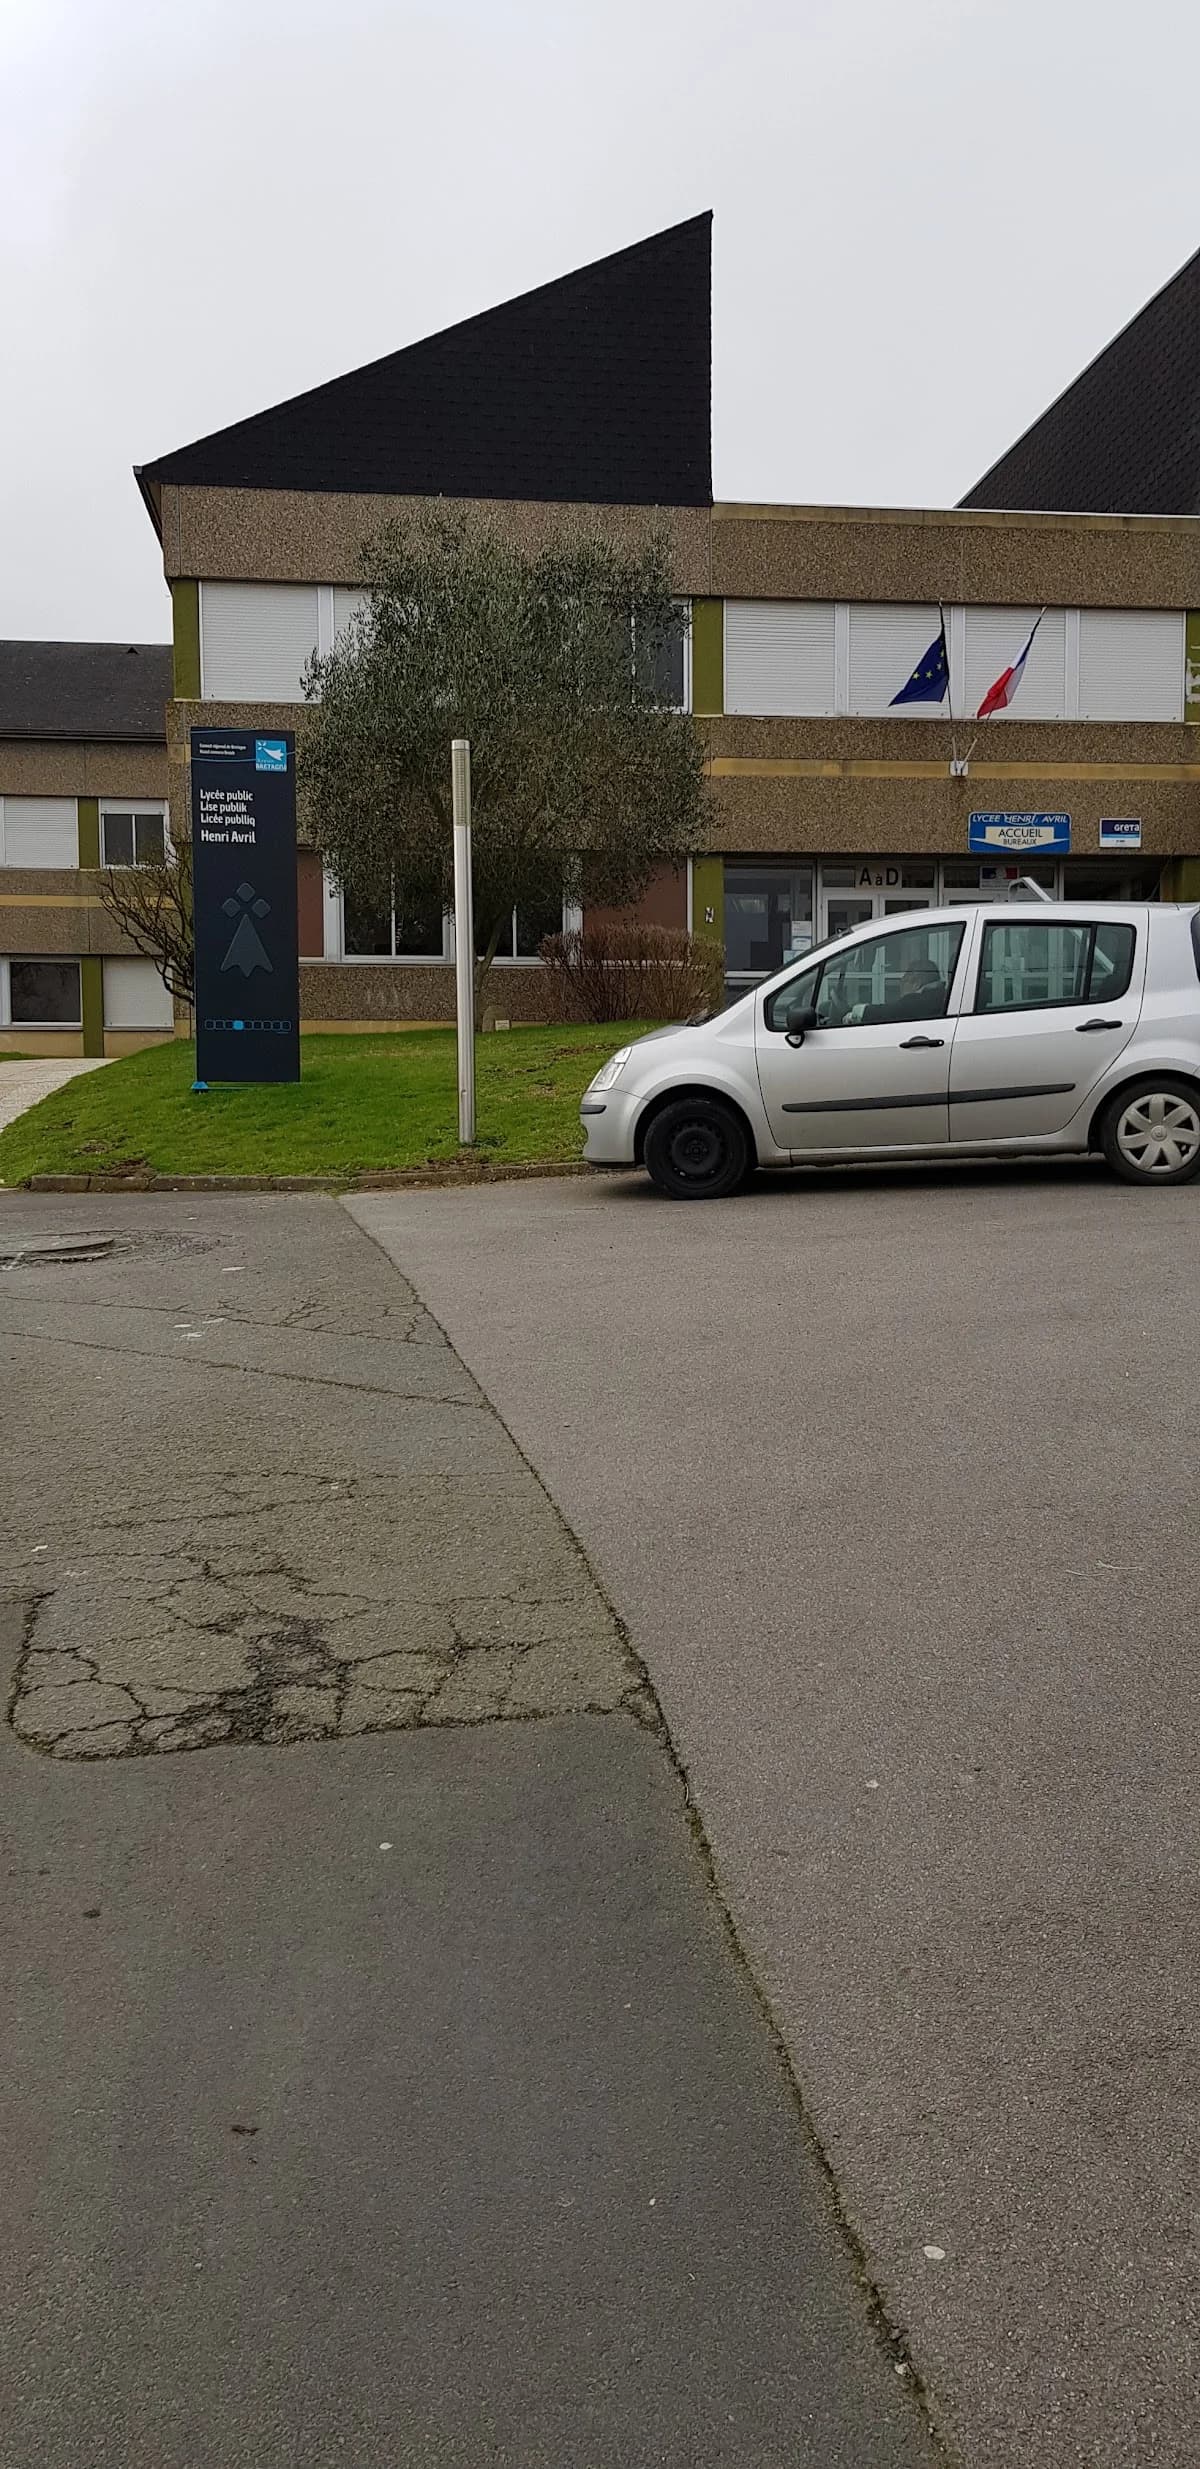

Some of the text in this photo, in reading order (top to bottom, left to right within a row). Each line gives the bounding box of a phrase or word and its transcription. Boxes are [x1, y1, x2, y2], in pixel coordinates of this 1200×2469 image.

[200, 789, 253, 802] Lycée public
[200, 801, 247, 813] Lise publik
[200, 813, 255, 827] Licée publliq
[1041, 815, 1068, 823] AVRIL
[201, 829, 256, 843] Henri Avril
[998, 828, 1043, 838] ACCUEIL
[859, 867, 899, 886] A à D
